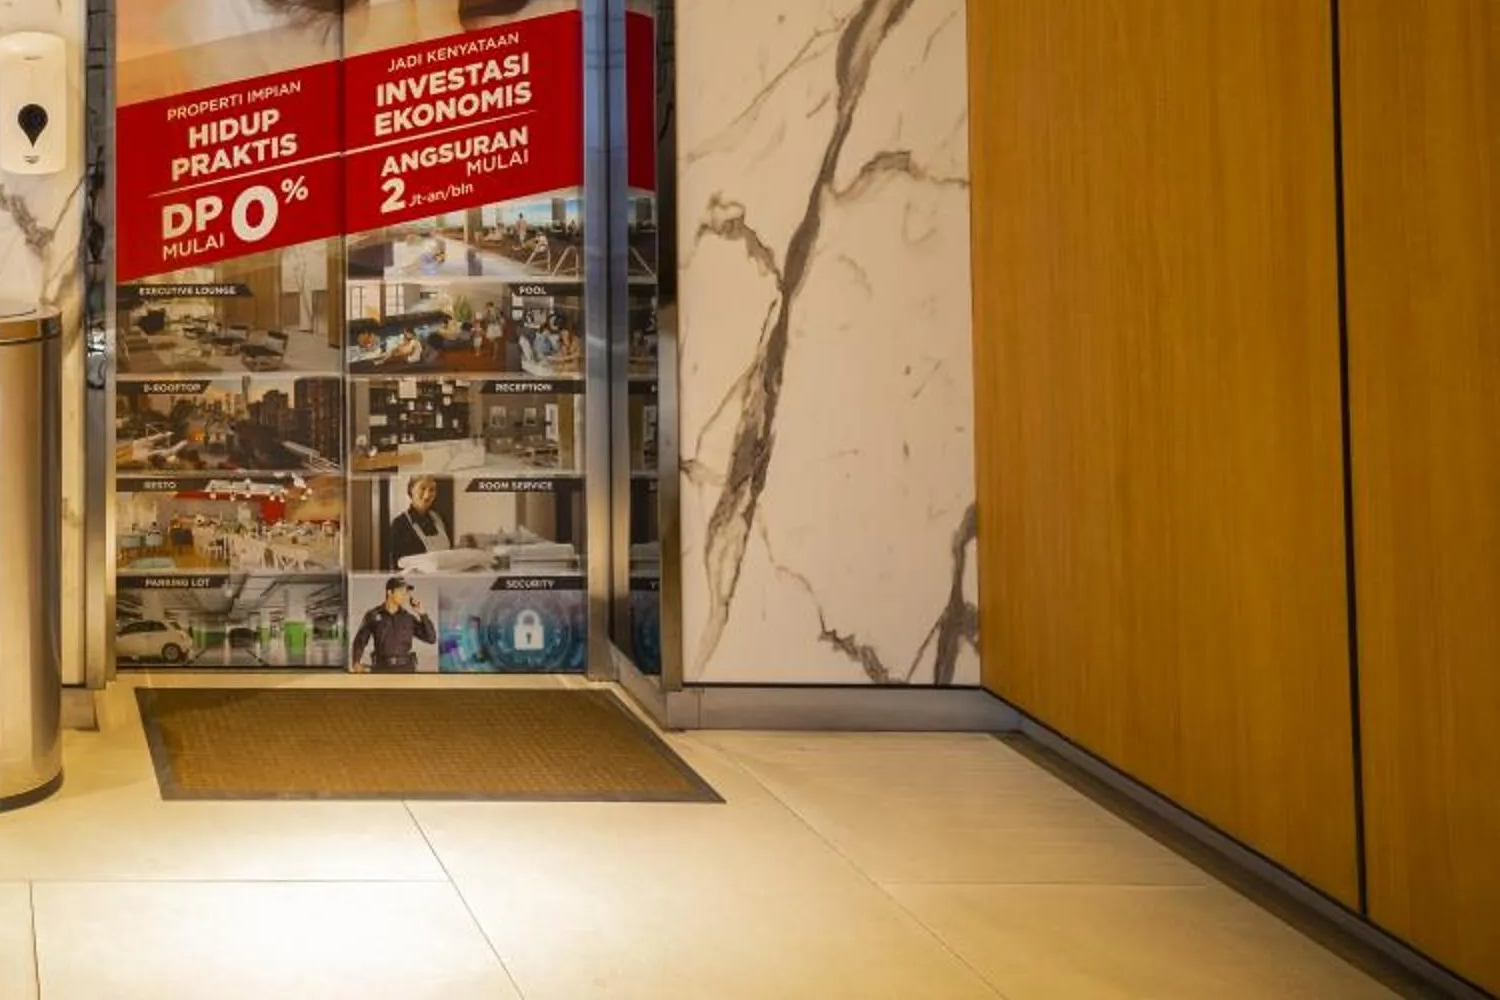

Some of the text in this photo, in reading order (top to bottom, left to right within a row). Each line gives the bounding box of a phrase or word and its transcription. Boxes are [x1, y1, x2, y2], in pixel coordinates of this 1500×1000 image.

[387, 32, 520, 73] JADI KENYATAAN
[376, 51, 530, 108] INVESTASI
[167, 79, 302, 121] PROPERTI IMPIAN
[374, 81, 533, 138] EKONOMIS
[188, 108, 281, 149] HIDUP
[171, 132, 298, 183] PRAKTIS
[381, 125, 529, 178] ANGSURAN
[466, 148, 529, 178] MULAI
[380, 177, 407, 215] 2
[162, 195, 224, 241] DP
[162, 232, 225, 262] MULAI
[139, 286, 236, 296] EXECUTIVE LOUNGE
[519, 286, 547, 295] POOL
[495, 383, 553, 393] RECEPTION
[479, 481, 553, 490] ROOM SERVICE
[145, 578, 211, 588] PARKING LOT
[506, 579, 555, 589] SECURITY
